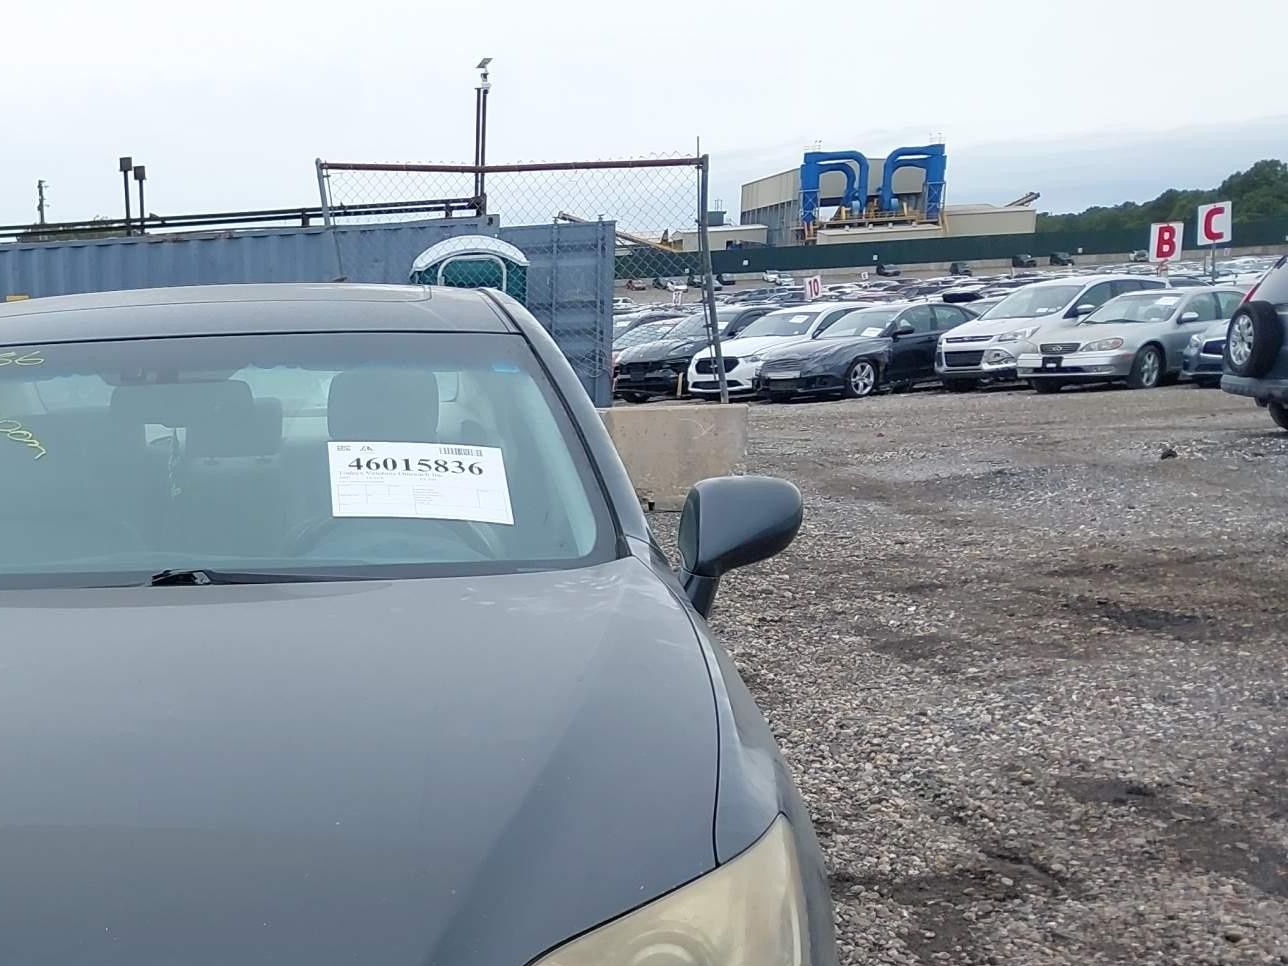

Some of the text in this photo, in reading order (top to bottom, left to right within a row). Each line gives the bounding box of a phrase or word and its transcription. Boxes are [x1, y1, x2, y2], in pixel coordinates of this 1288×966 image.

[1204, 206, 1225, 241] C
[1156, 225, 1176, 259] B
[808, 278, 820, 297] 10
[348, 457, 484, 475] 46015836
